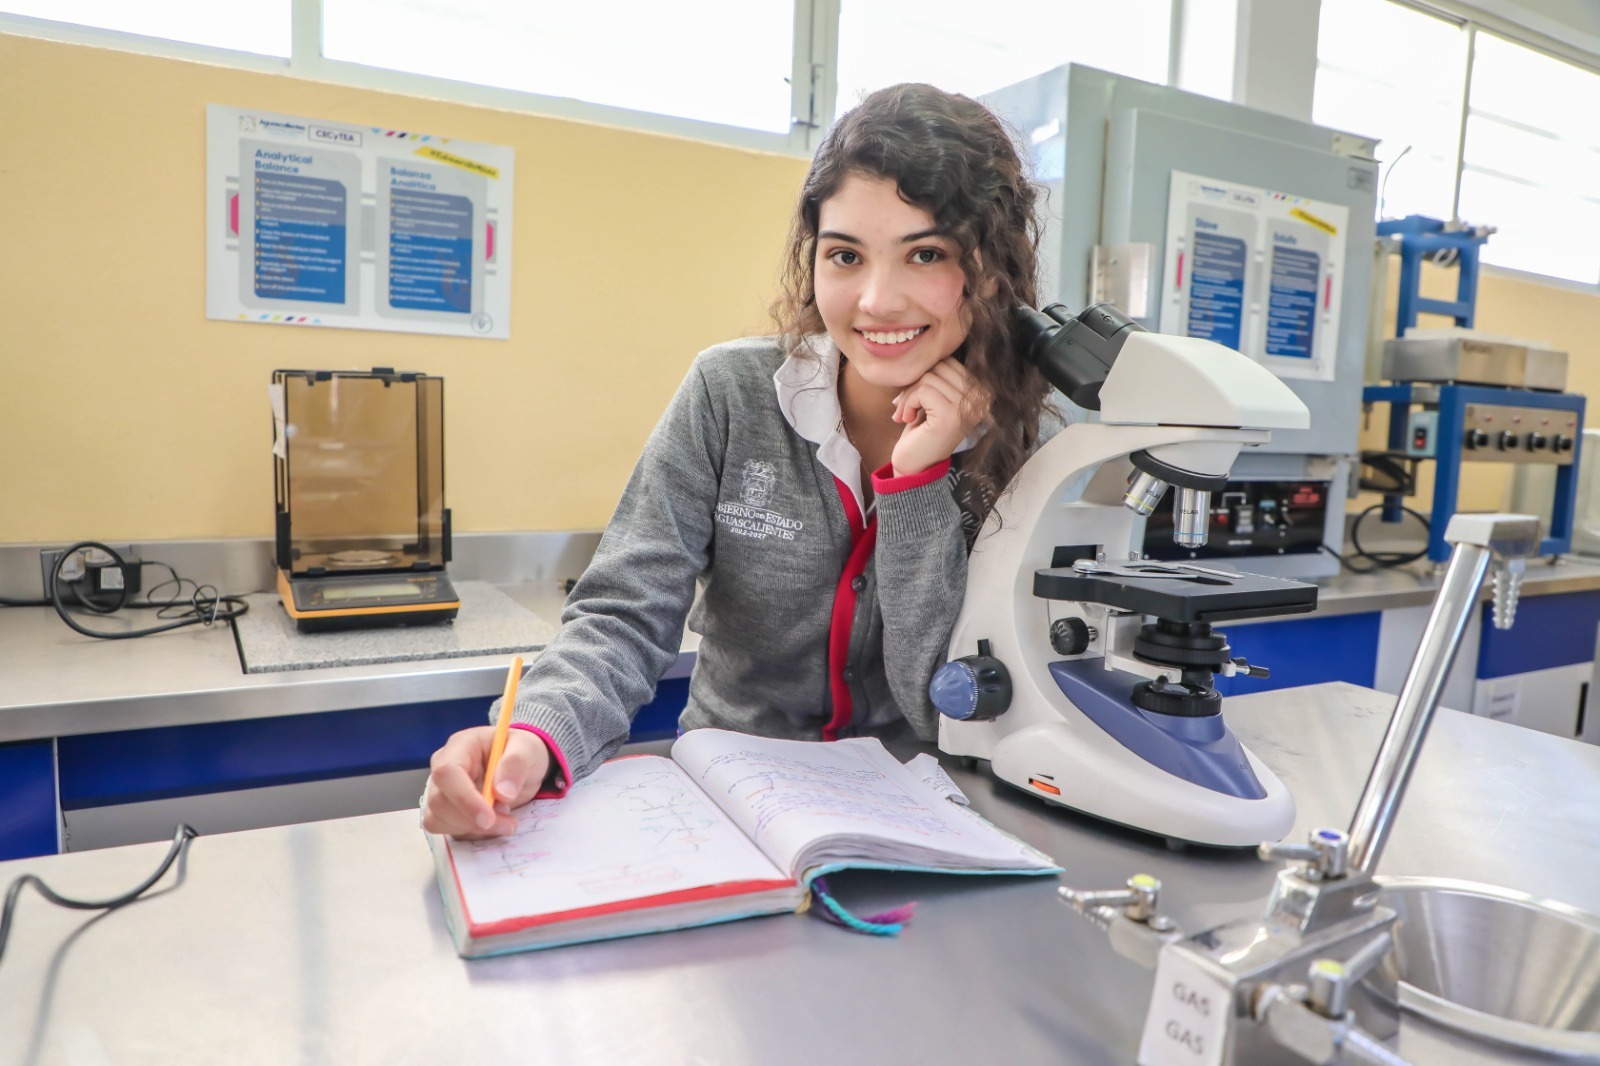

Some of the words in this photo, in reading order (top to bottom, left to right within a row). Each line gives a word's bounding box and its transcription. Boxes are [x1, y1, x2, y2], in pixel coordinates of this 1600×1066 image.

[315, 129, 355, 142] CECyTEA
[255, 149, 313, 164] Analytical
[254, 160, 299, 174] Balance
[390, 167, 432, 180] Balanza
[717, 502, 756, 519] BIERNO
[765, 512, 803, 531] ESTADO
[730, 526, 767, 539] 2022-2027
[1172, 981, 1211, 1017] GAS
[1165, 1019, 1204, 1055] GAS
